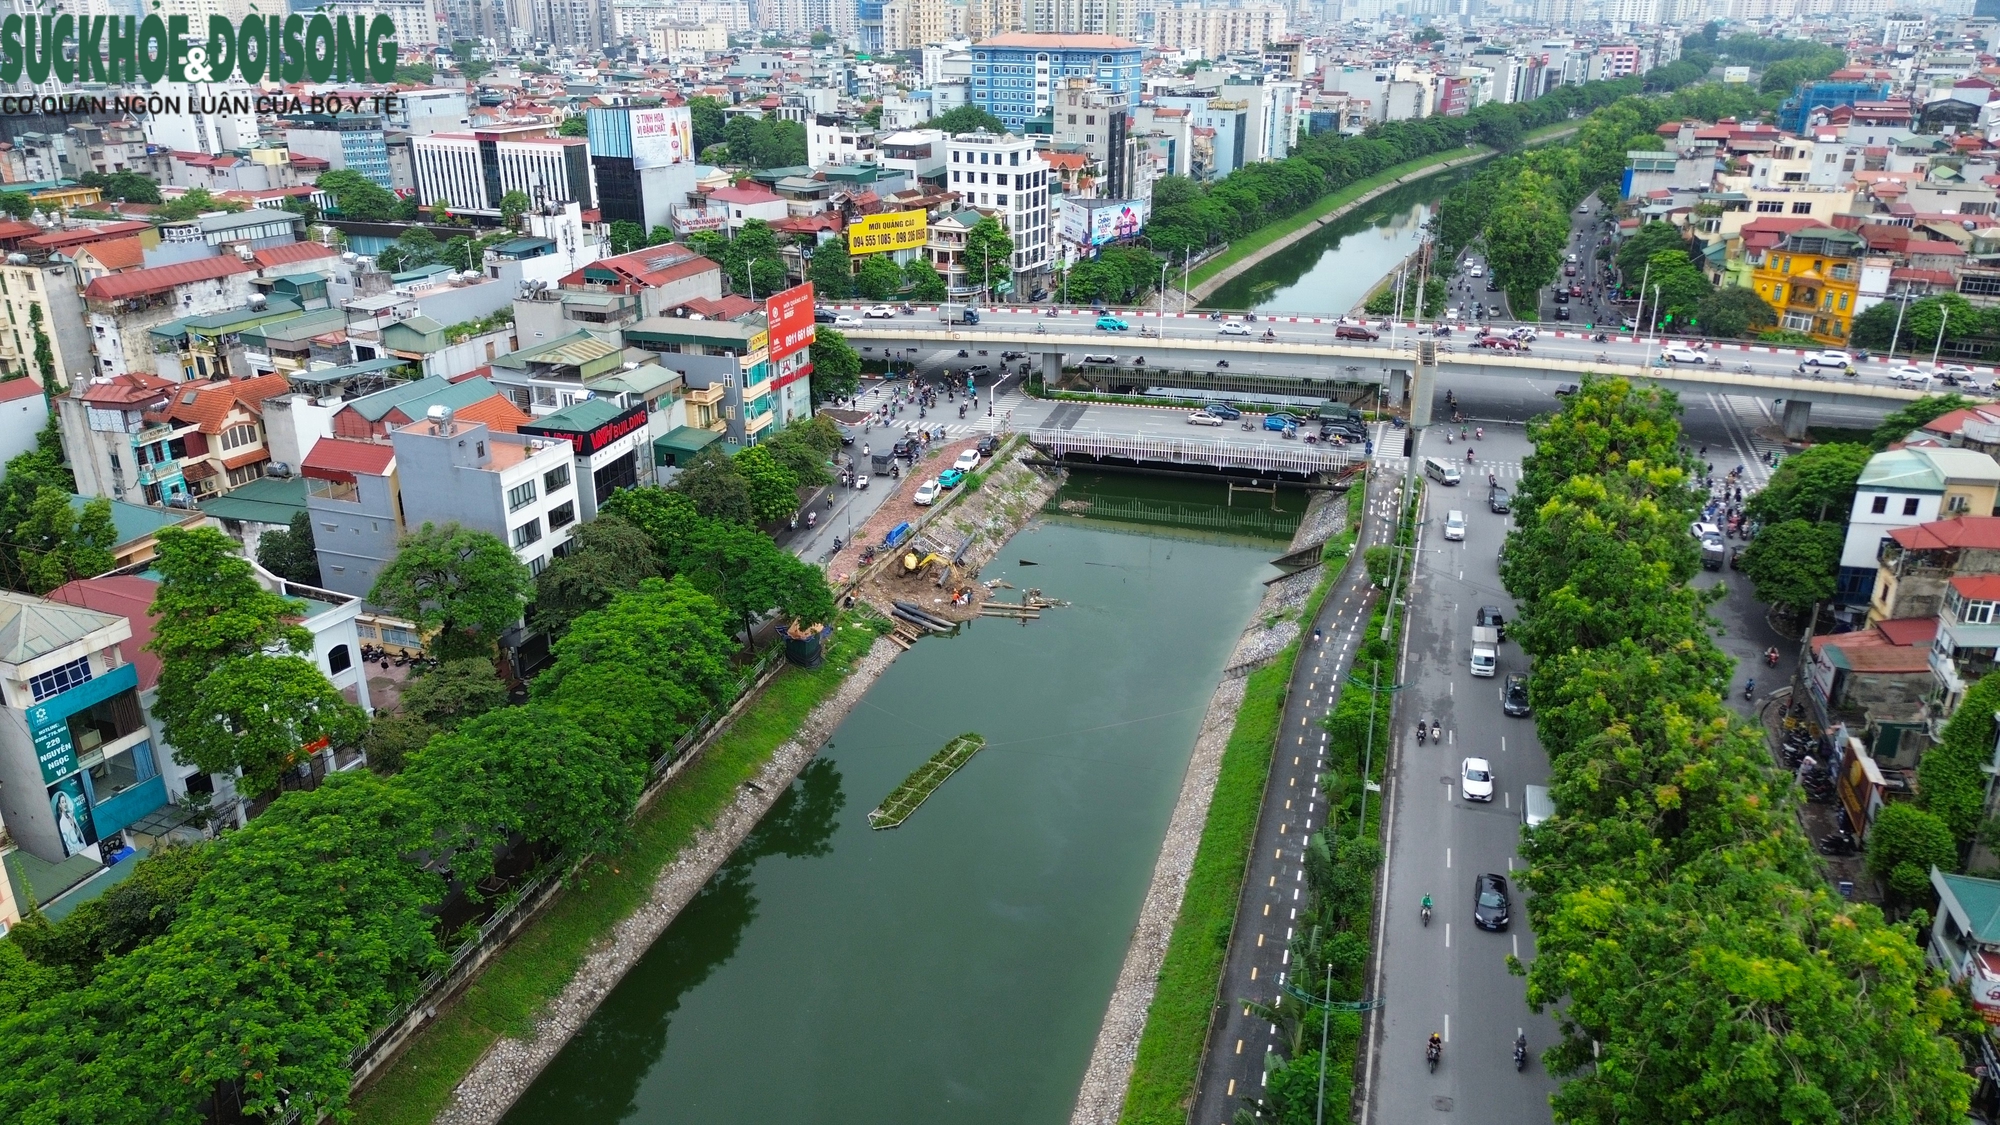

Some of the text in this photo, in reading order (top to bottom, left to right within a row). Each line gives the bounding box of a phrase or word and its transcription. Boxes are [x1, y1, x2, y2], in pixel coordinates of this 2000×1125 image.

[868, 221, 880, 231] MỜI
[882, 219, 904, 230] QUẢNG
[613, 409, 647, 439] BUILDING
[47, 754, 70, 770] NGỌC
